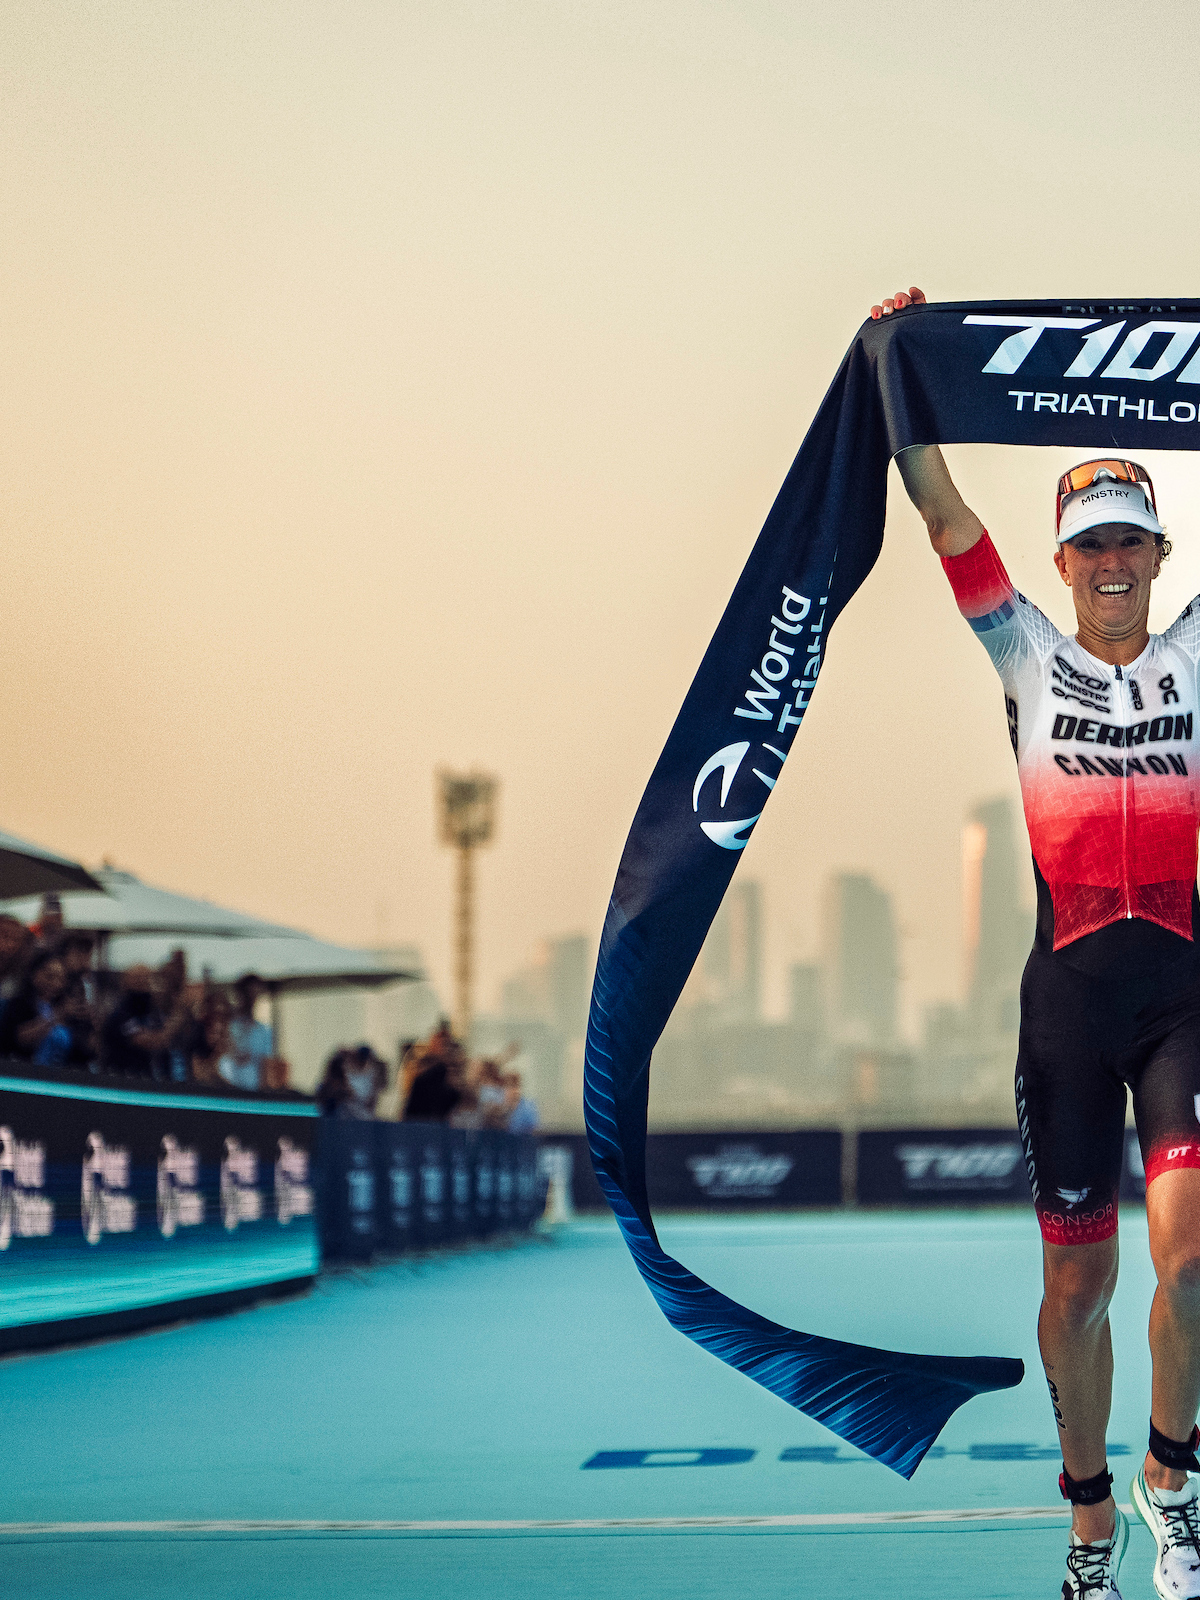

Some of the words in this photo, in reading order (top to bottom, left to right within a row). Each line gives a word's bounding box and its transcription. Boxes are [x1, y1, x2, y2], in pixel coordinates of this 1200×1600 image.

[1081, 489, 1129, 505] MNSTRY
[733, 585, 812, 721] World
[1064, 679, 1111, 702] MNSTRY
[1052, 713, 1193, 748] DERRON
[1054, 754, 1189, 777] CANYON
[1167, 1145, 1192, 1160] DT
[1043, 1203, 1113, 1227] CONSOR
